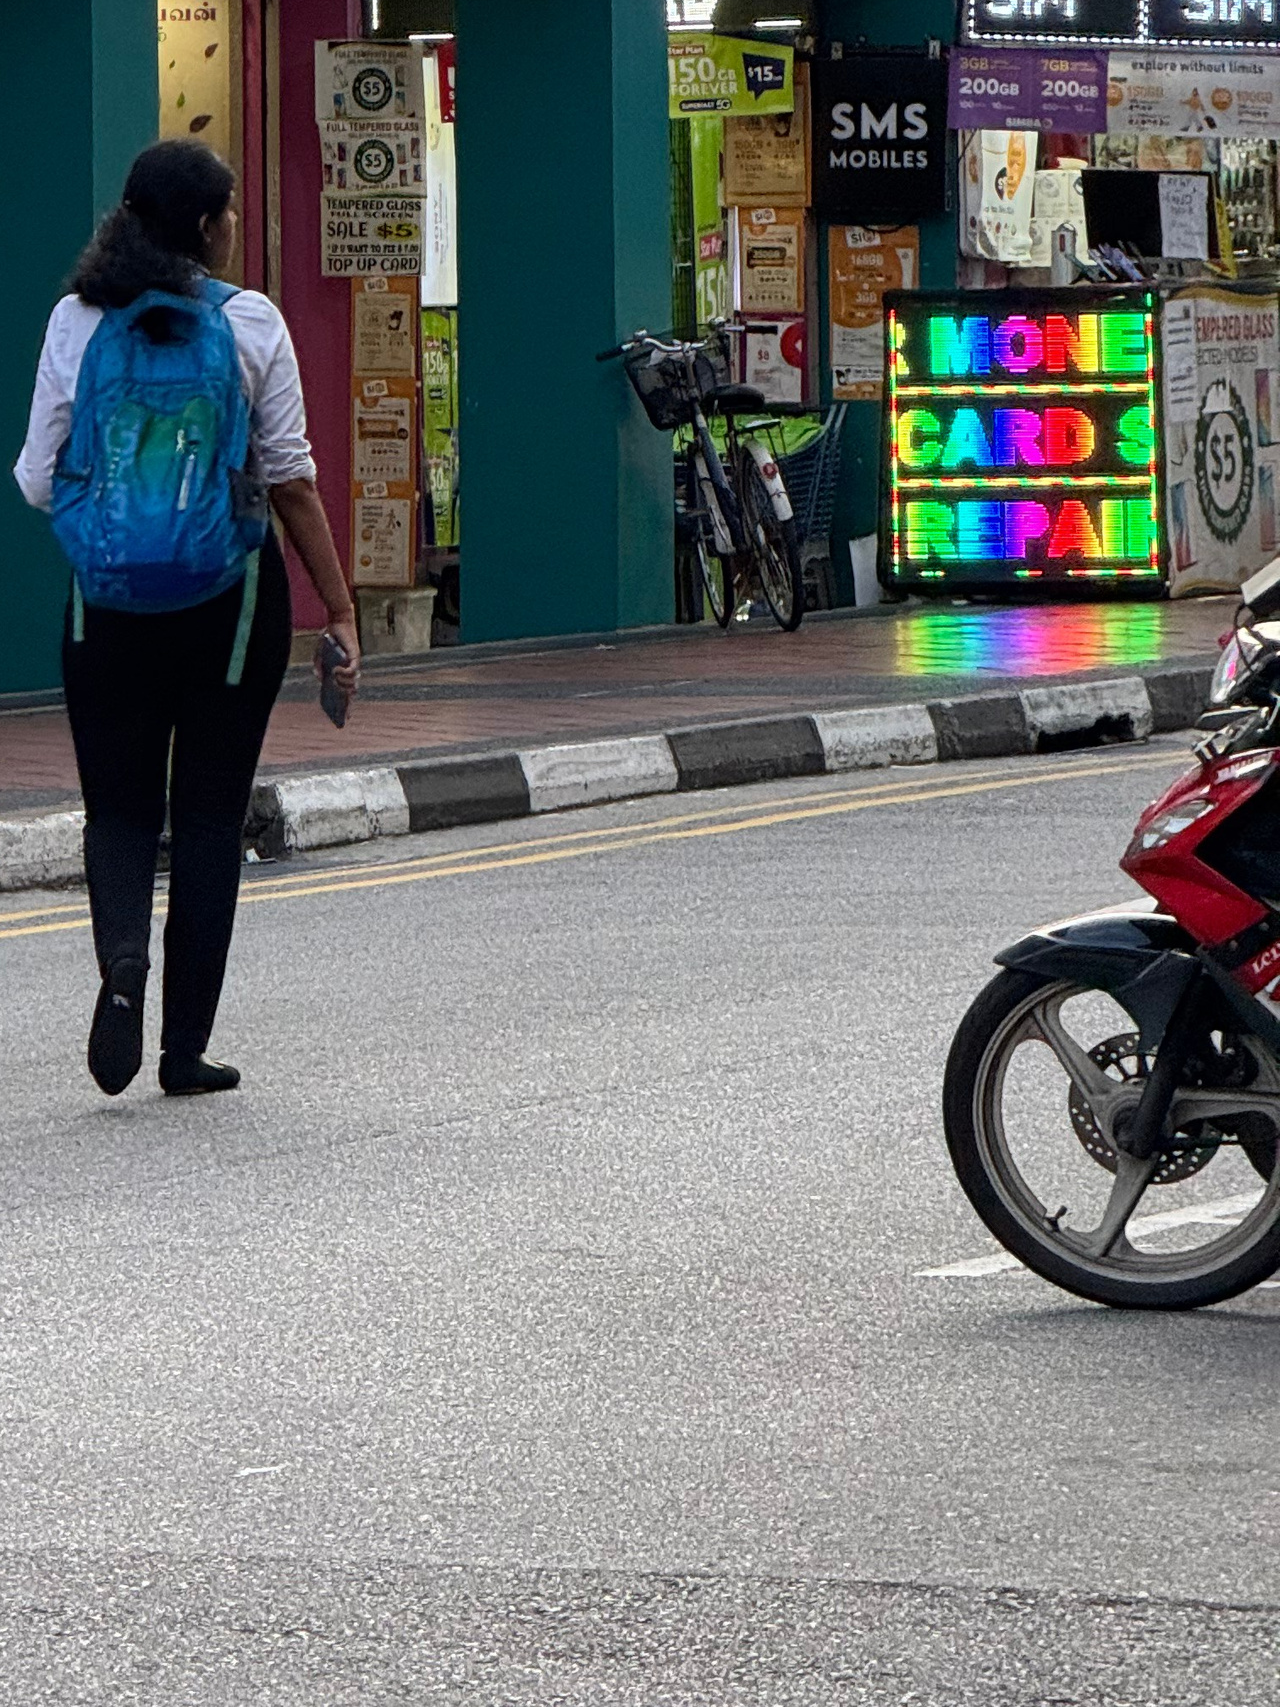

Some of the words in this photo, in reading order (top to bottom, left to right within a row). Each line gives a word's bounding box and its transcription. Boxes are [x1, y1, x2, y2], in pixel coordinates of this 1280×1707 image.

[363, 81, 381, 97] $5
[326, 123, 346, 132] FULL
[349, 122, 391, 132] TEMPERED
[393, 122, 419, 132] GLASS
[830, 102, 929, 141] SMS
[365, 154, 381, 169] $5
[829, 150, 929, 169] MOBILES
[327, 198, 384, 210] TEMPERED
[327, 220, 368, 239] SALE
[327, 257, 353, 272] TOP
[357, 258, 377, 272] UP
[380, 257, 419, 272] CARD
[1195, 316, 1240, 342] EMPERED
[898, 406, 1095, 467] CARD
[1211, 430, 1236, 489] $5
